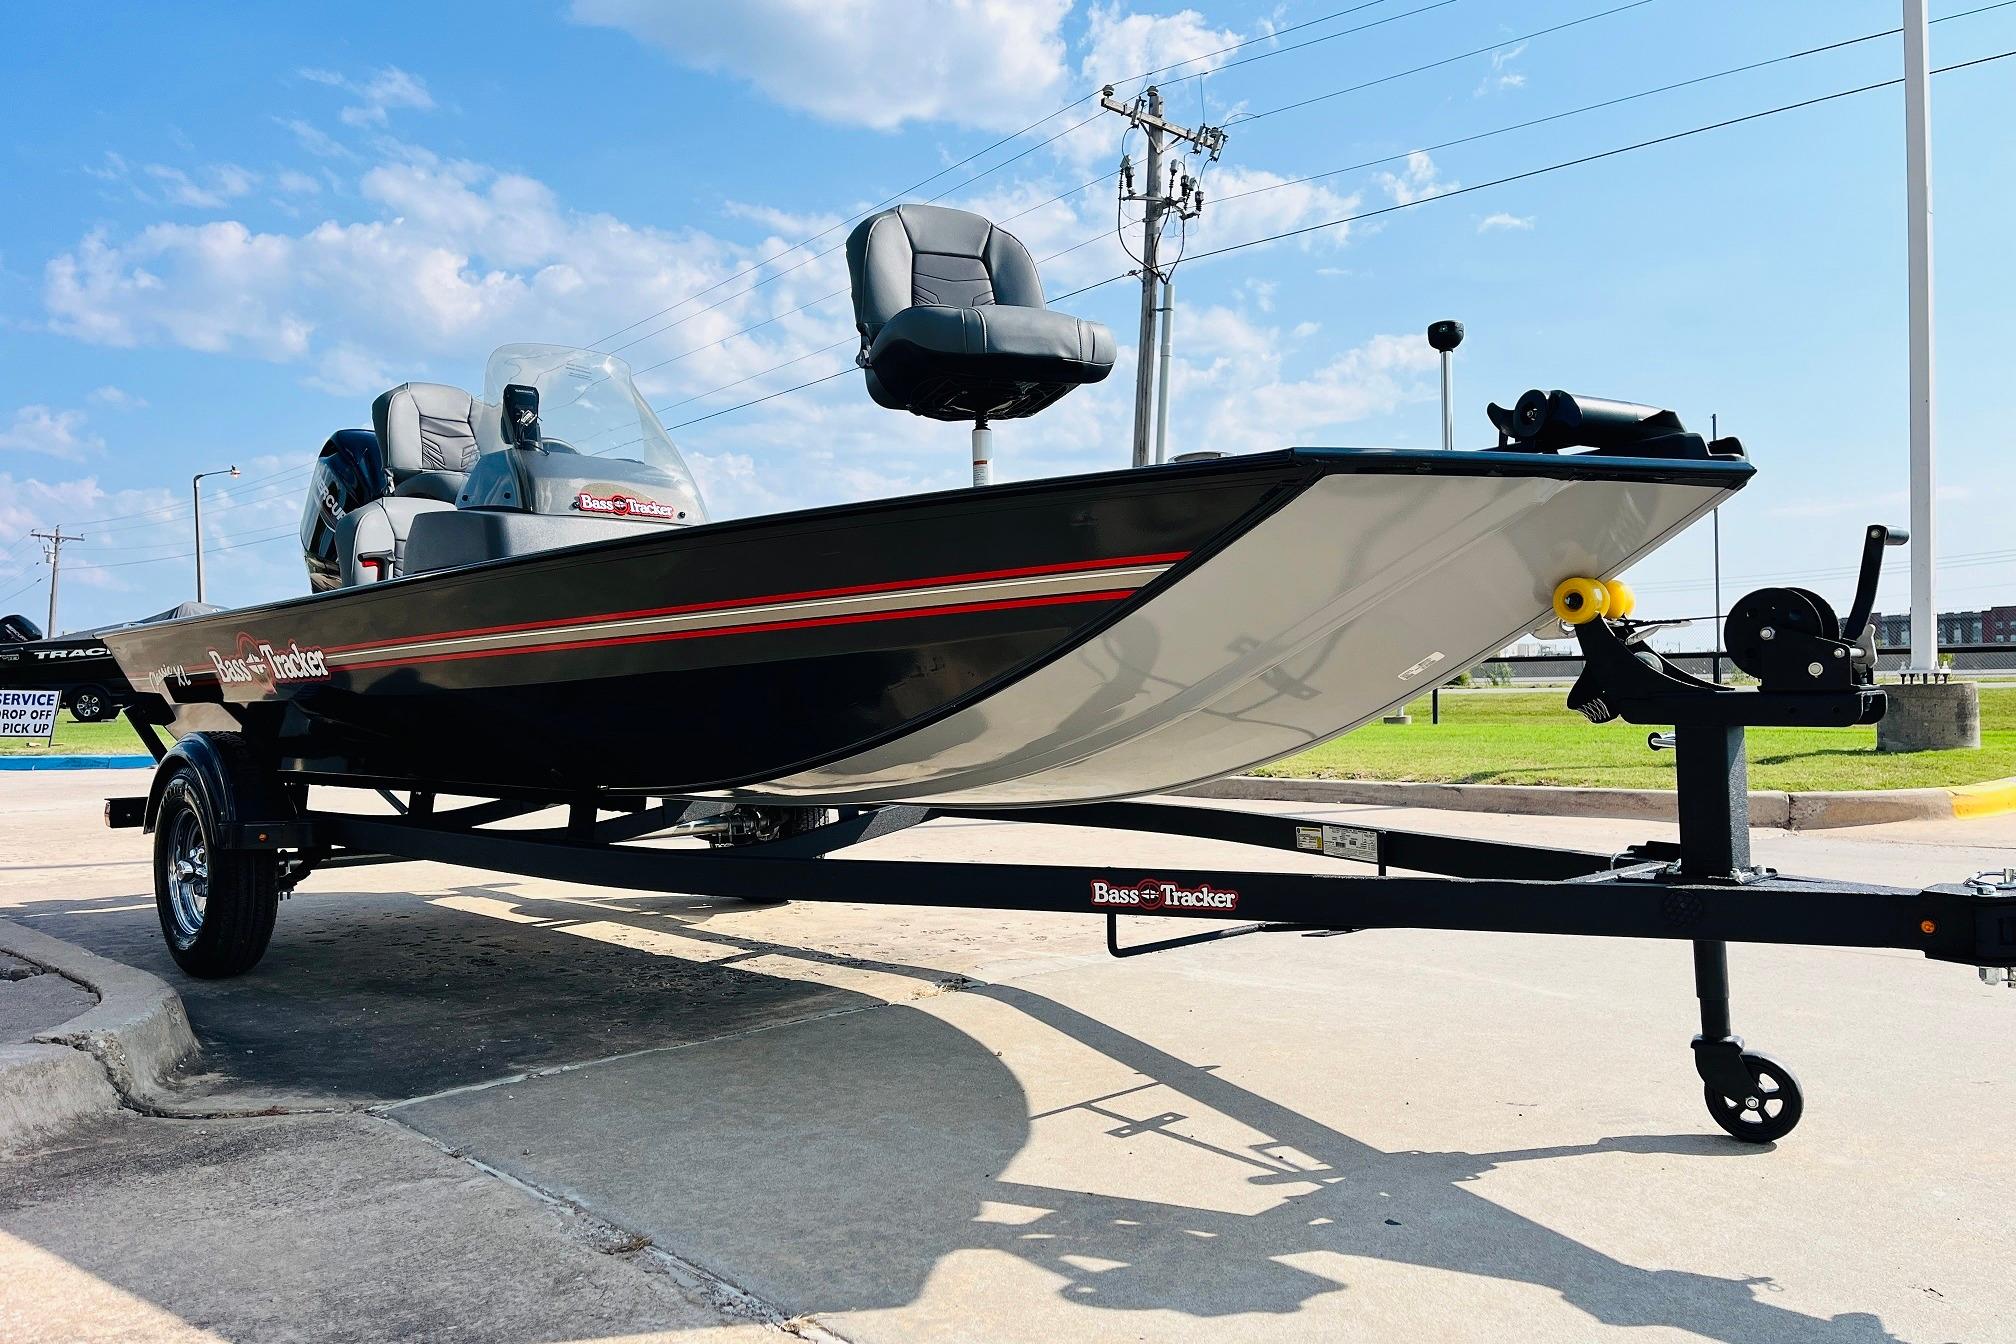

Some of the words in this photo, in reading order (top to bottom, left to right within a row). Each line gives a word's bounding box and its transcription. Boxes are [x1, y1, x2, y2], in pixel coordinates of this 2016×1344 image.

[580, 494, 614, 511] Bass
[626, 498, 673, 516] Tracker
[208, 650, 252, 683] Bass
[258, 643, 329, 680] Tracker
[0, 709, 27, 720] ROP
[30, 709, 53, 720] OFF
[2, 723, 31, 734] PICK
[33, 723, 49, 734] UP
[1093, 882, 1140, 904] Bass
[1160, 884, 1236, 908] Tracker
